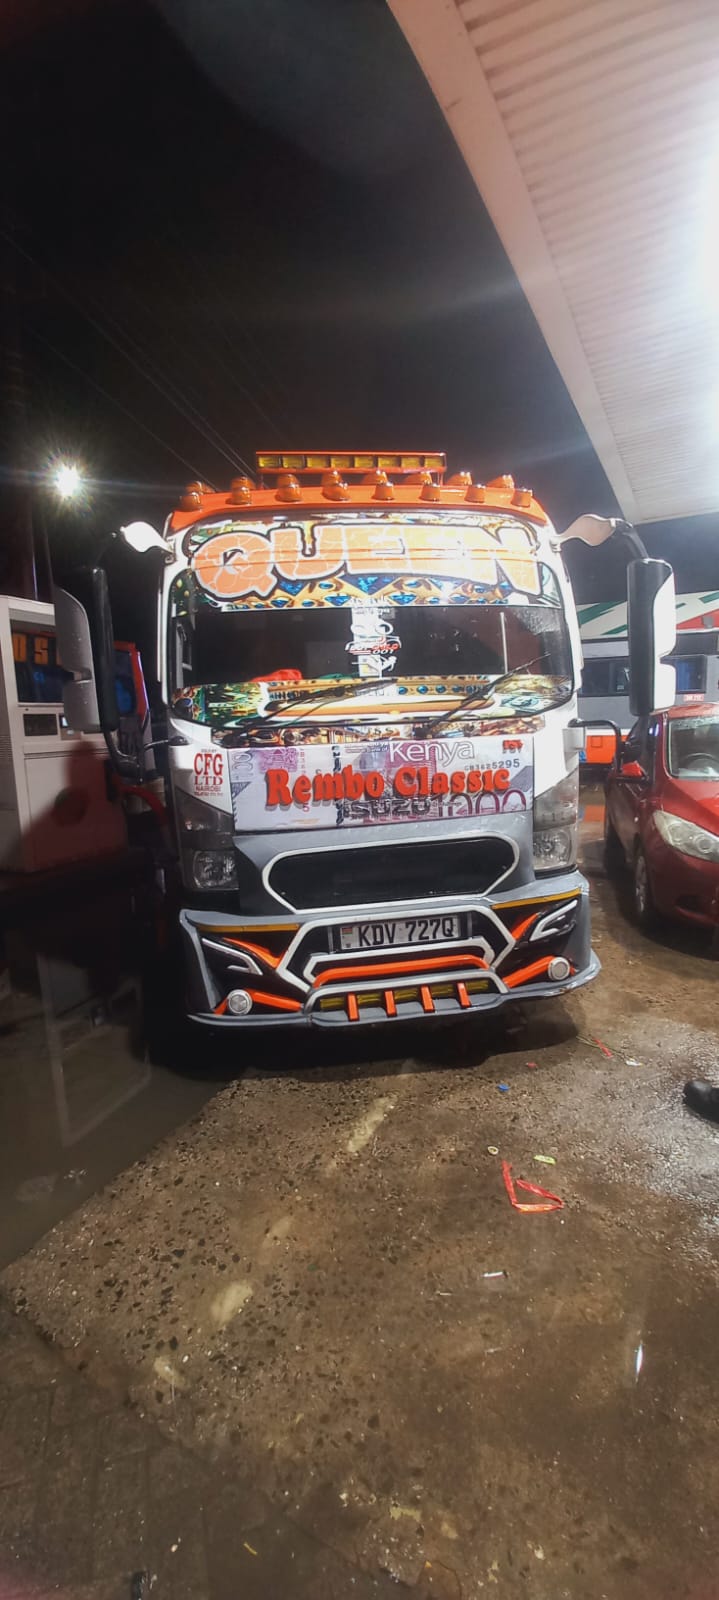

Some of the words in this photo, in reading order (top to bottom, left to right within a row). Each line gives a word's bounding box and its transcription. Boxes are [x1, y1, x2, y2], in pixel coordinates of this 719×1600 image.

[192, 523, 543, 599] QUEEN
[193, 753, 223, 776] CFG
[387, 739, 475, 768] Kenya
[194, 776, 223, 785] LTD
[265, 765, 384, 807] Rembo
[393, 764, 511, 799] Classic
[358, 923, 396, 947] KDV
[405, 917, 454, 942] 727Q
